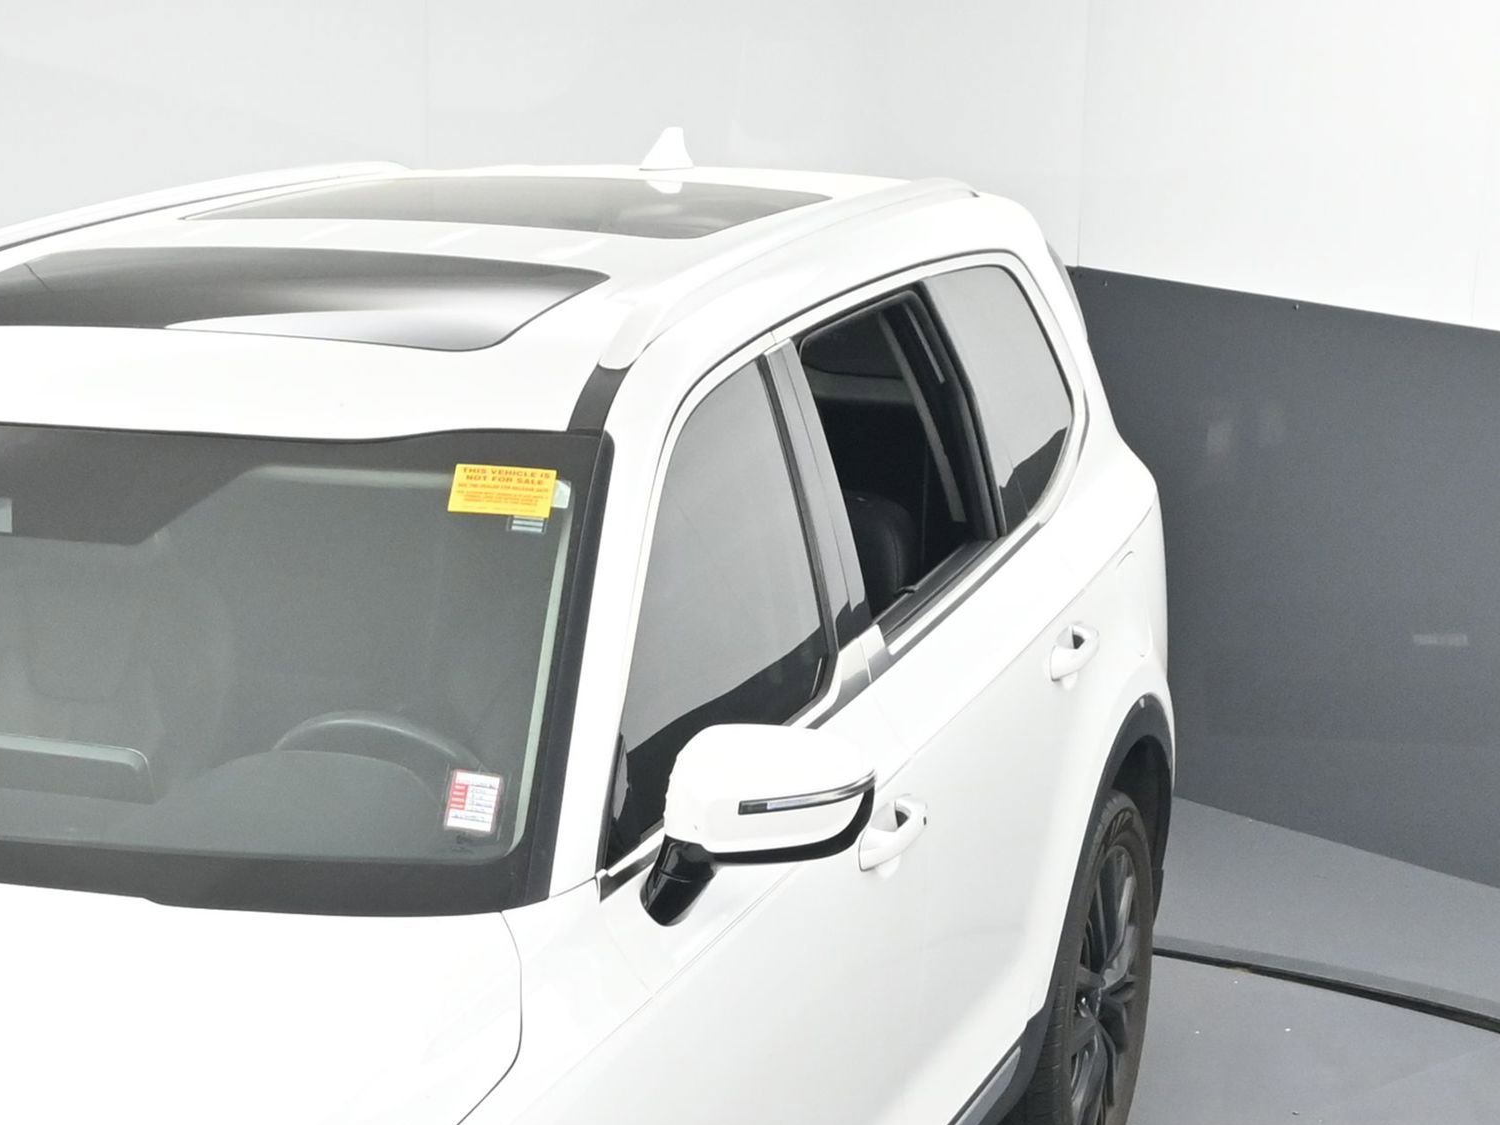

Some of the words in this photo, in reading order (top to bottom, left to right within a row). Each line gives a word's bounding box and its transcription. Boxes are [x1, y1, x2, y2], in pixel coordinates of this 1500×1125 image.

[462, 467, 487, 475] THIS
[491, 469, 536, 478] VEHICLE
[466, 474, 487, 482] NOT
[516, 477, 545, 486] SALE
